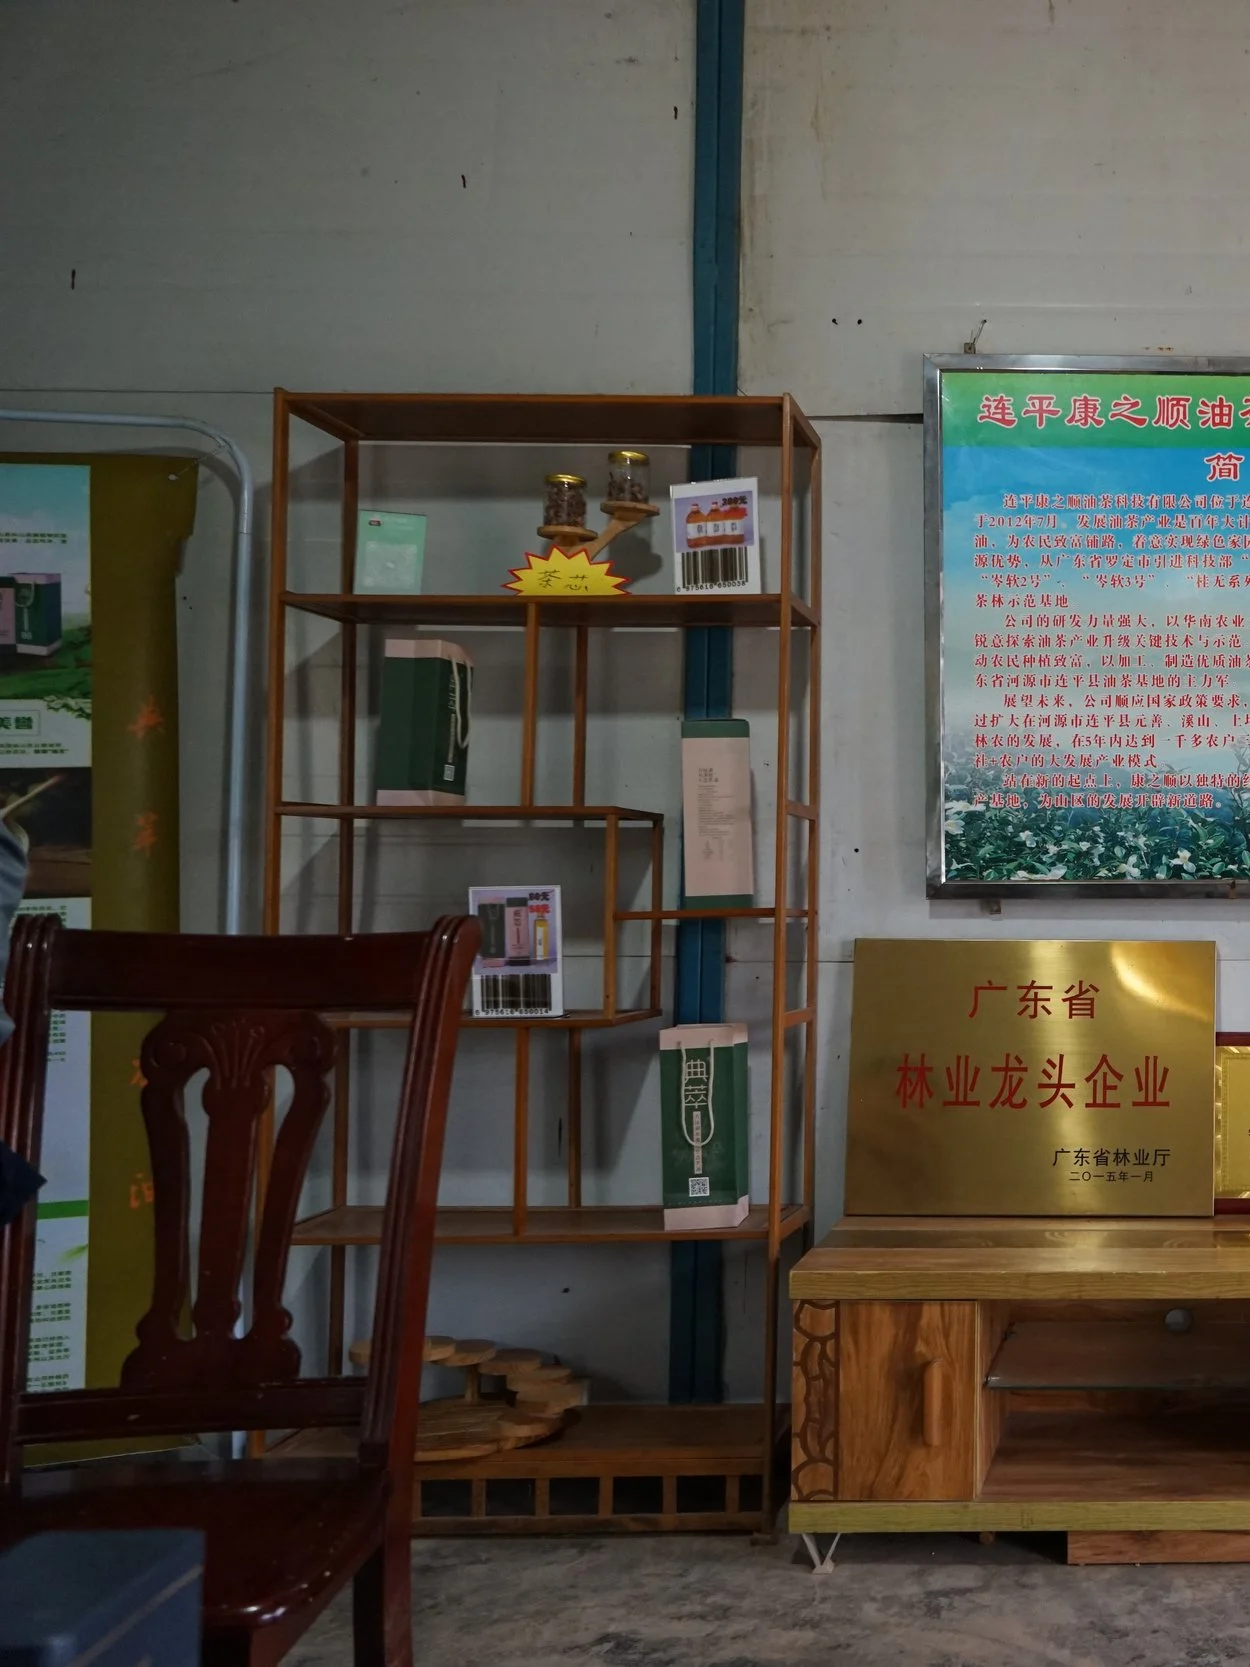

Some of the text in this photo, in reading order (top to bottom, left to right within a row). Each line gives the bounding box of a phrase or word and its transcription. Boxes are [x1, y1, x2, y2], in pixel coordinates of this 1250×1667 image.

[968, 980, 1101, 1020] 广东省
[895, 1052, 1171, 1110] 林业龙头企业
[1052, 1148, 1172, 1168] 广东省林业厅
